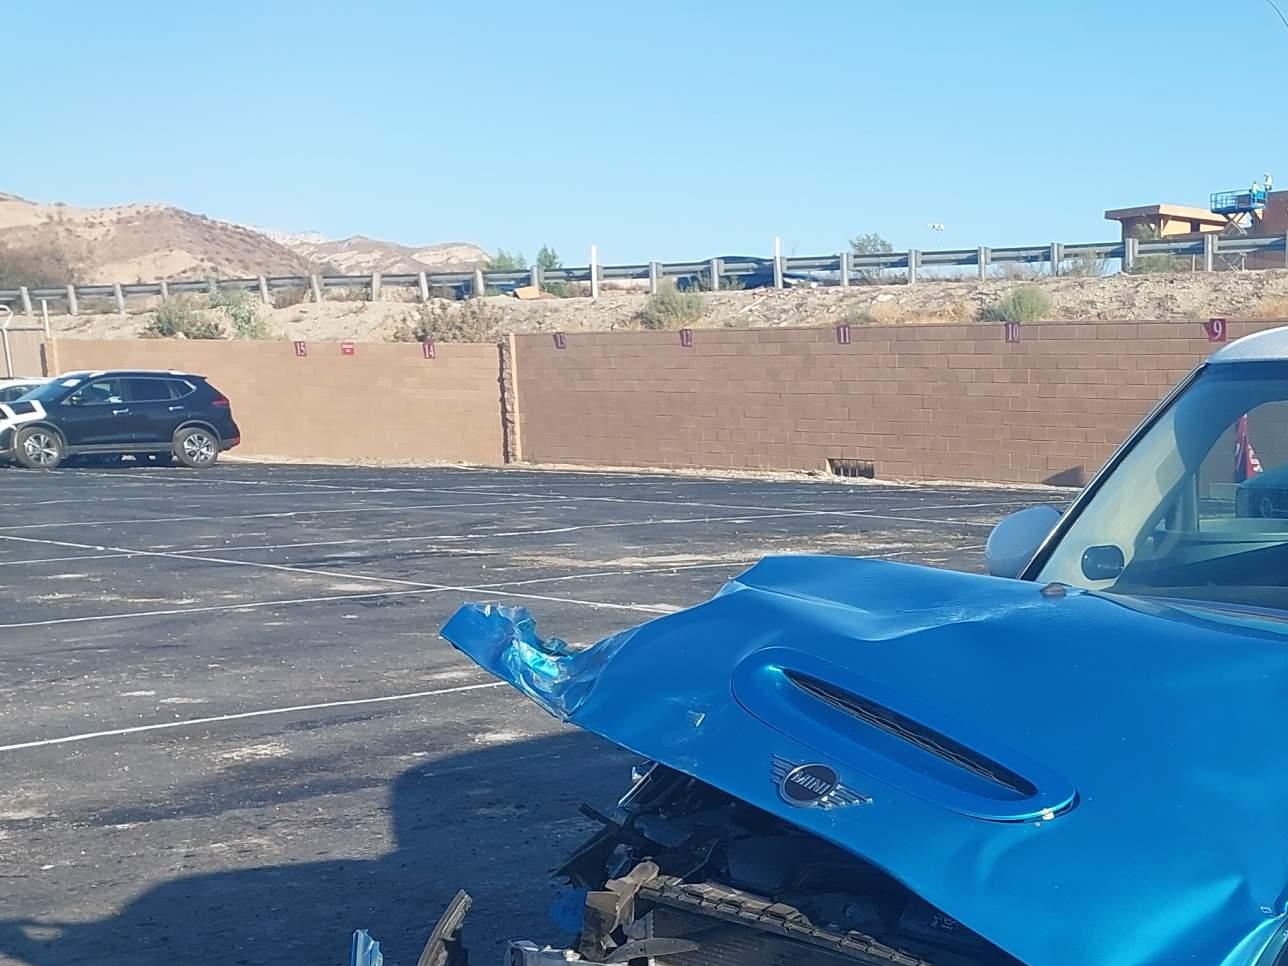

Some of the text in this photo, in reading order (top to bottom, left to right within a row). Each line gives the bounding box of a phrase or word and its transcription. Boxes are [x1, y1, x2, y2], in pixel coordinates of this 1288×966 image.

[840, 326, 849, 343] 11
[1008, 323, 1019, 342] 10
[296, 341, 306, 356] 15
[425, 343, 435, 358] 14
[790, 770, 832, 795] MINI
